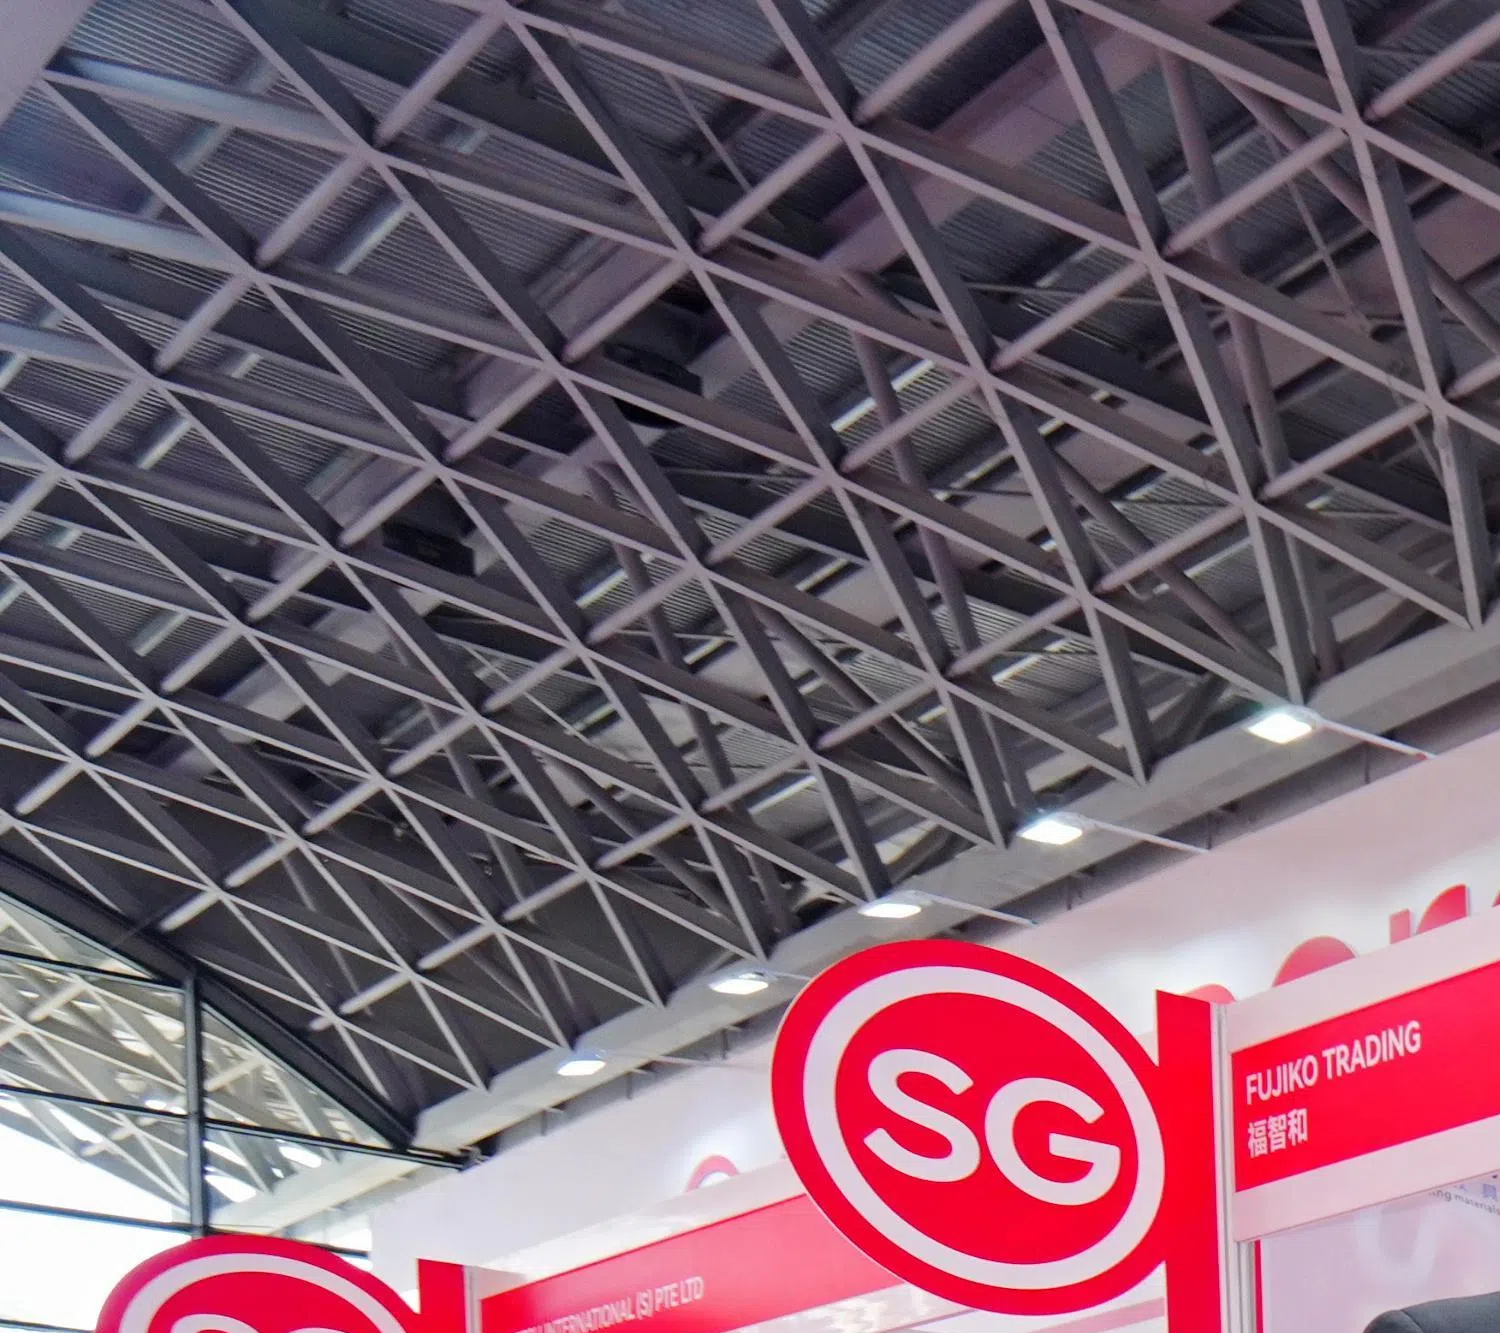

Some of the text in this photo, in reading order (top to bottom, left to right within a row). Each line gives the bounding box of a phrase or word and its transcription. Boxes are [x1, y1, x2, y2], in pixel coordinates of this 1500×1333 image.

[1246, 1020, 1422, 1106] FUJIKO TRADING
[863, 1047, 1122, 1206] SG
[1247, 1108, 1309, 1158] 福智和
[654, 1282, 681, 1312] PTE
[680, 1275, 705, 1304] LTD
